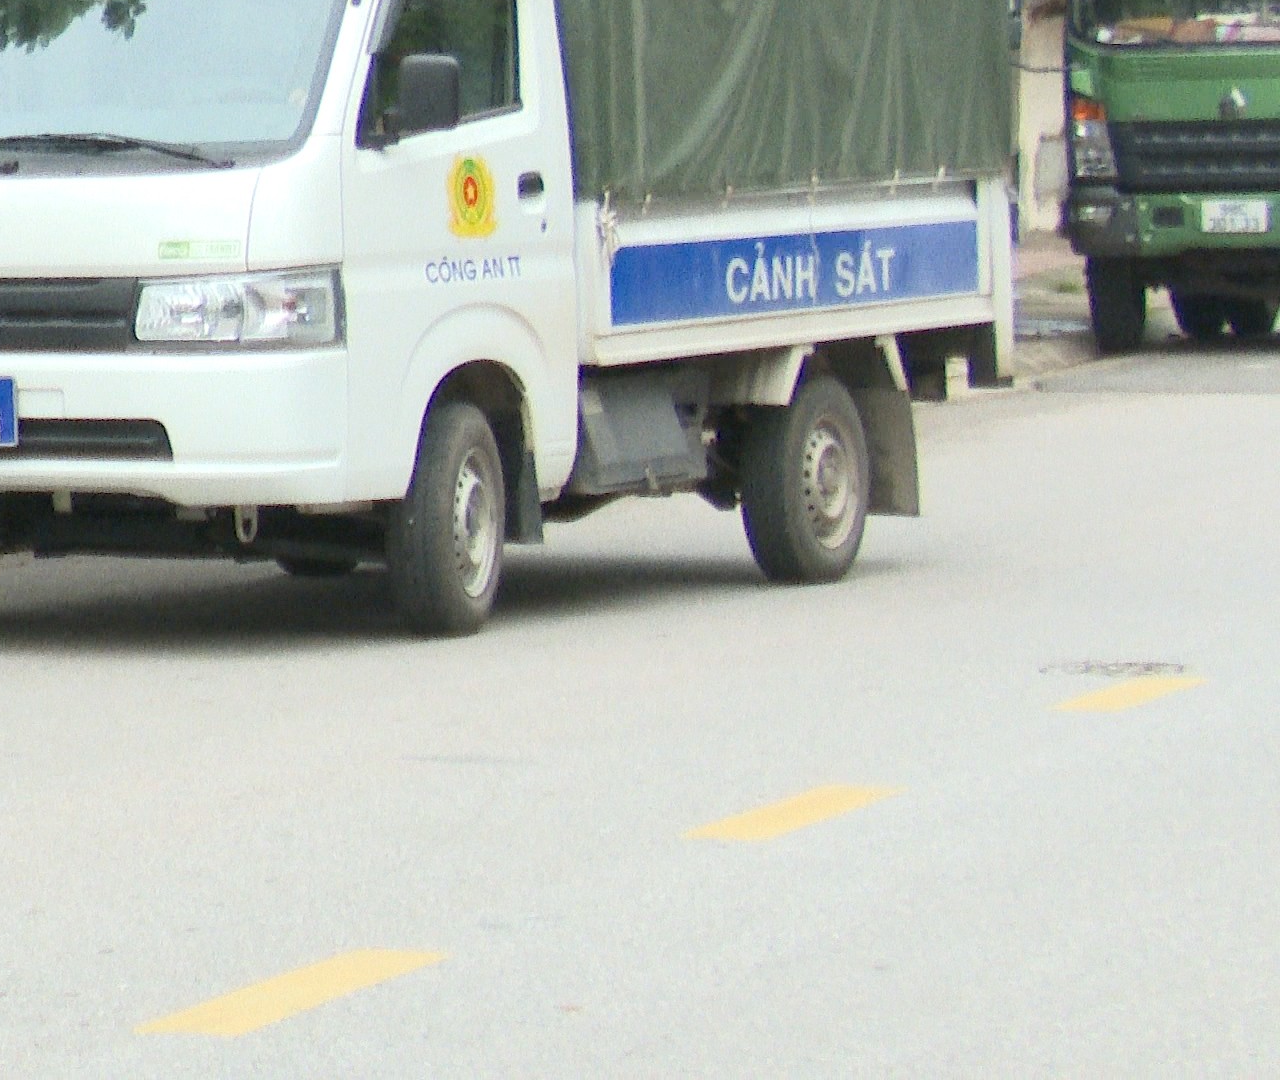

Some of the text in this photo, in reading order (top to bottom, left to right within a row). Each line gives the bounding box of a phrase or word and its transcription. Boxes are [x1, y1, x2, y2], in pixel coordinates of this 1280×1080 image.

[425, 255, 477, 283] CÔNG
[482, 257, 505, 279] AN
[726, 239, 896, 304] CẢNH SÁT
